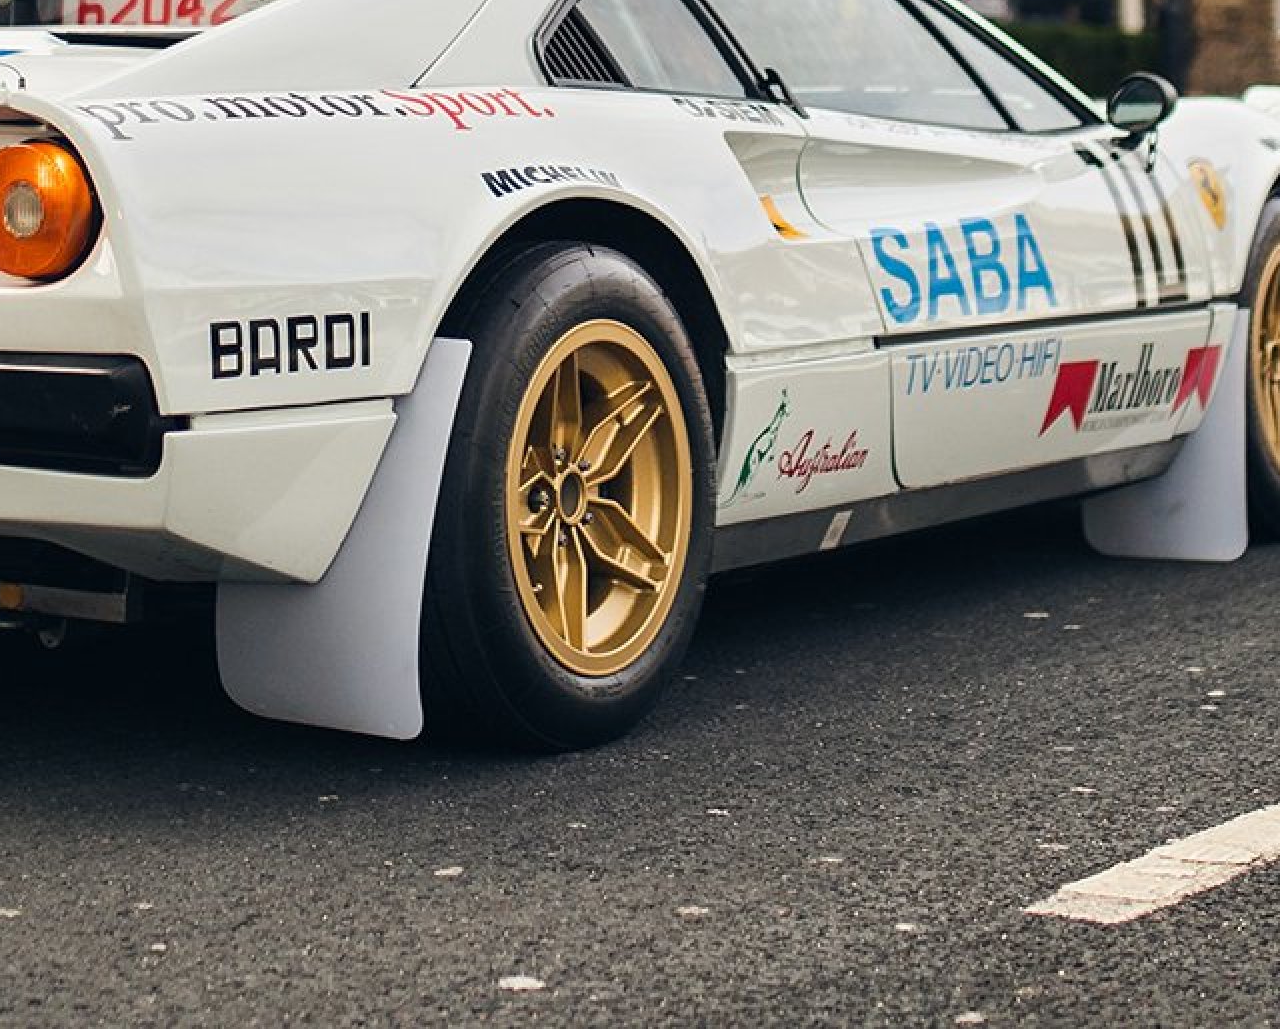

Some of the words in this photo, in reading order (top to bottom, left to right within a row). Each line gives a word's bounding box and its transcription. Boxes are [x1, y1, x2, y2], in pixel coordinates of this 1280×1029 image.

[870, 213, 1057, 323] SABA
[210, 311, 370, 379] BARDI
[1087, 342, 1181, 414] Marlboro
